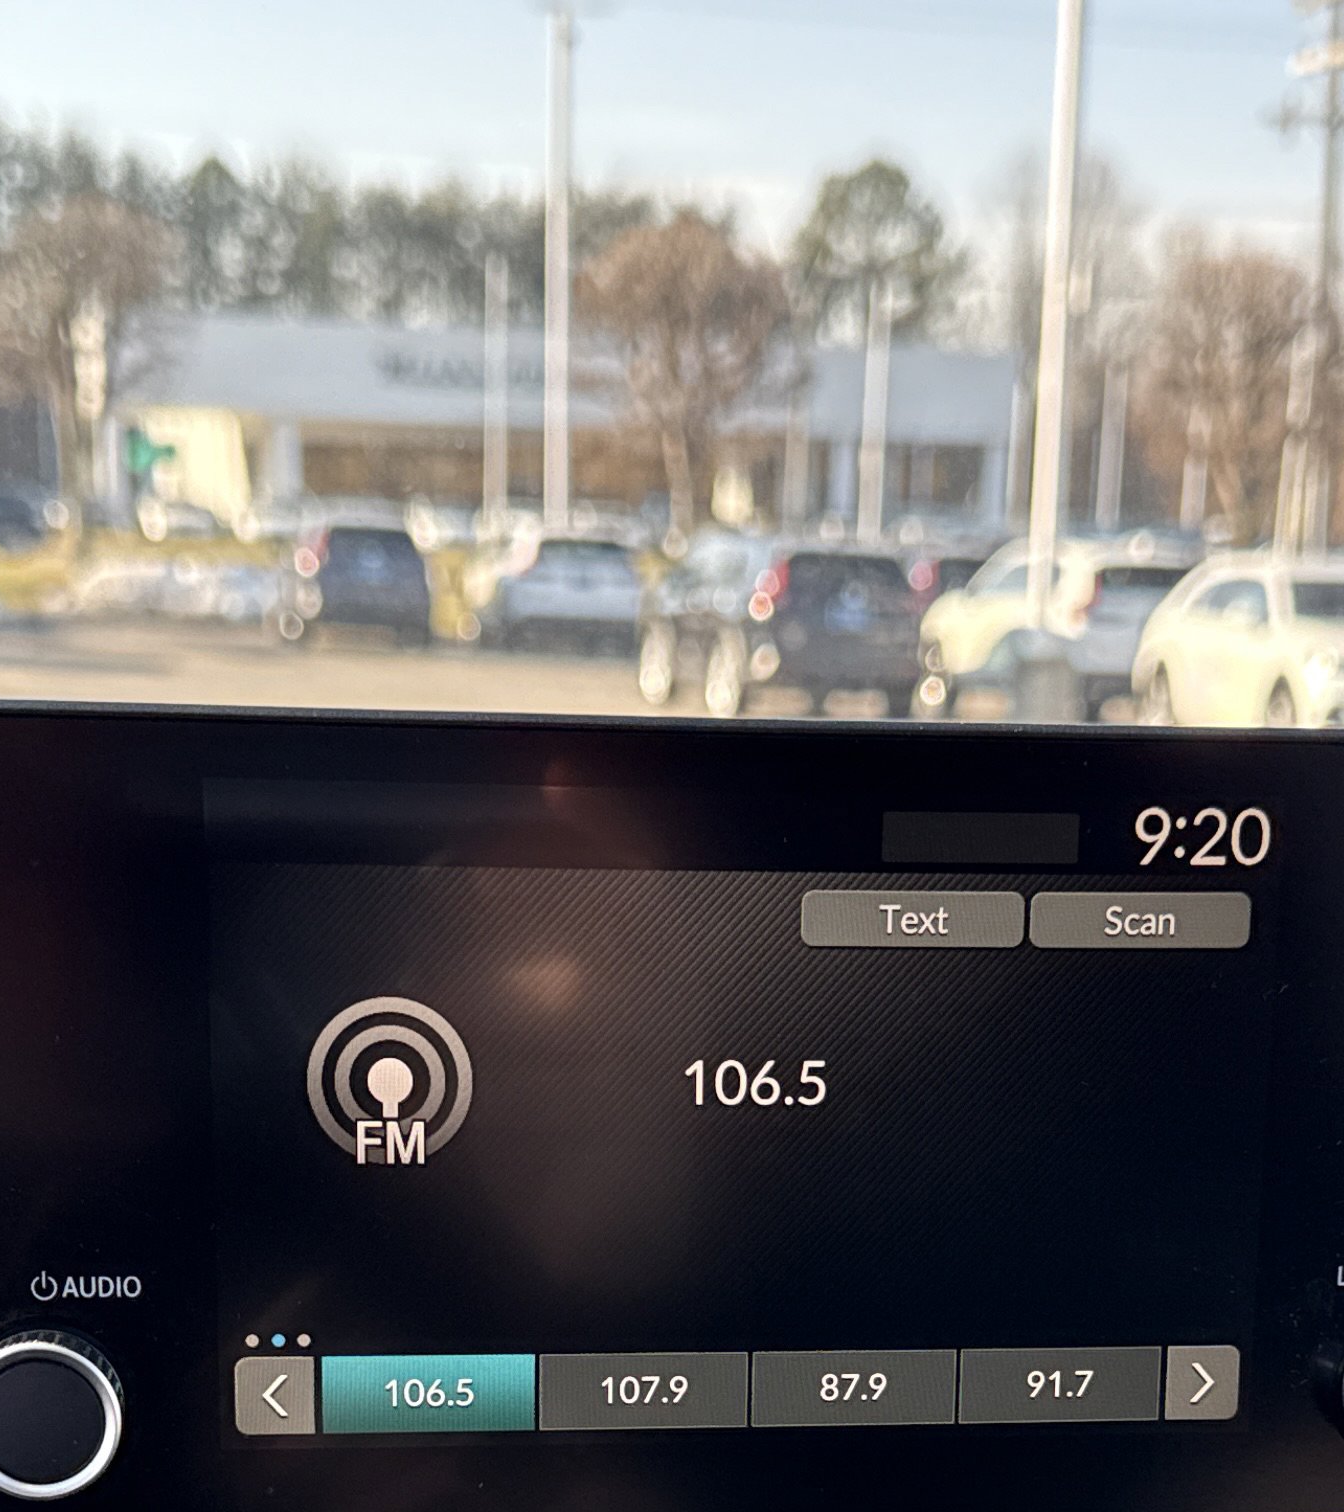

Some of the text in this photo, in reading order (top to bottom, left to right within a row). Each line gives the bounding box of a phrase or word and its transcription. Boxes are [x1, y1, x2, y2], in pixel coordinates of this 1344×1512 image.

[1135, 806, 1271, 866] 9:20
[879, 904, 949, 934] Text
[1104, 905, 1176, 935] Scan
[684, 1059, 827, 1106] 106.5
[356, 1120, 425, 1164] FM
[62, 1275, 142, 1298] AUDIO
[384, 1379, 475, 1408] 106.5
[601, 1375, 689, 1404] 107.9
[819, 1372, 887, 1401] 87.9
[1027, 1369, 1094, 1398] 91.7
